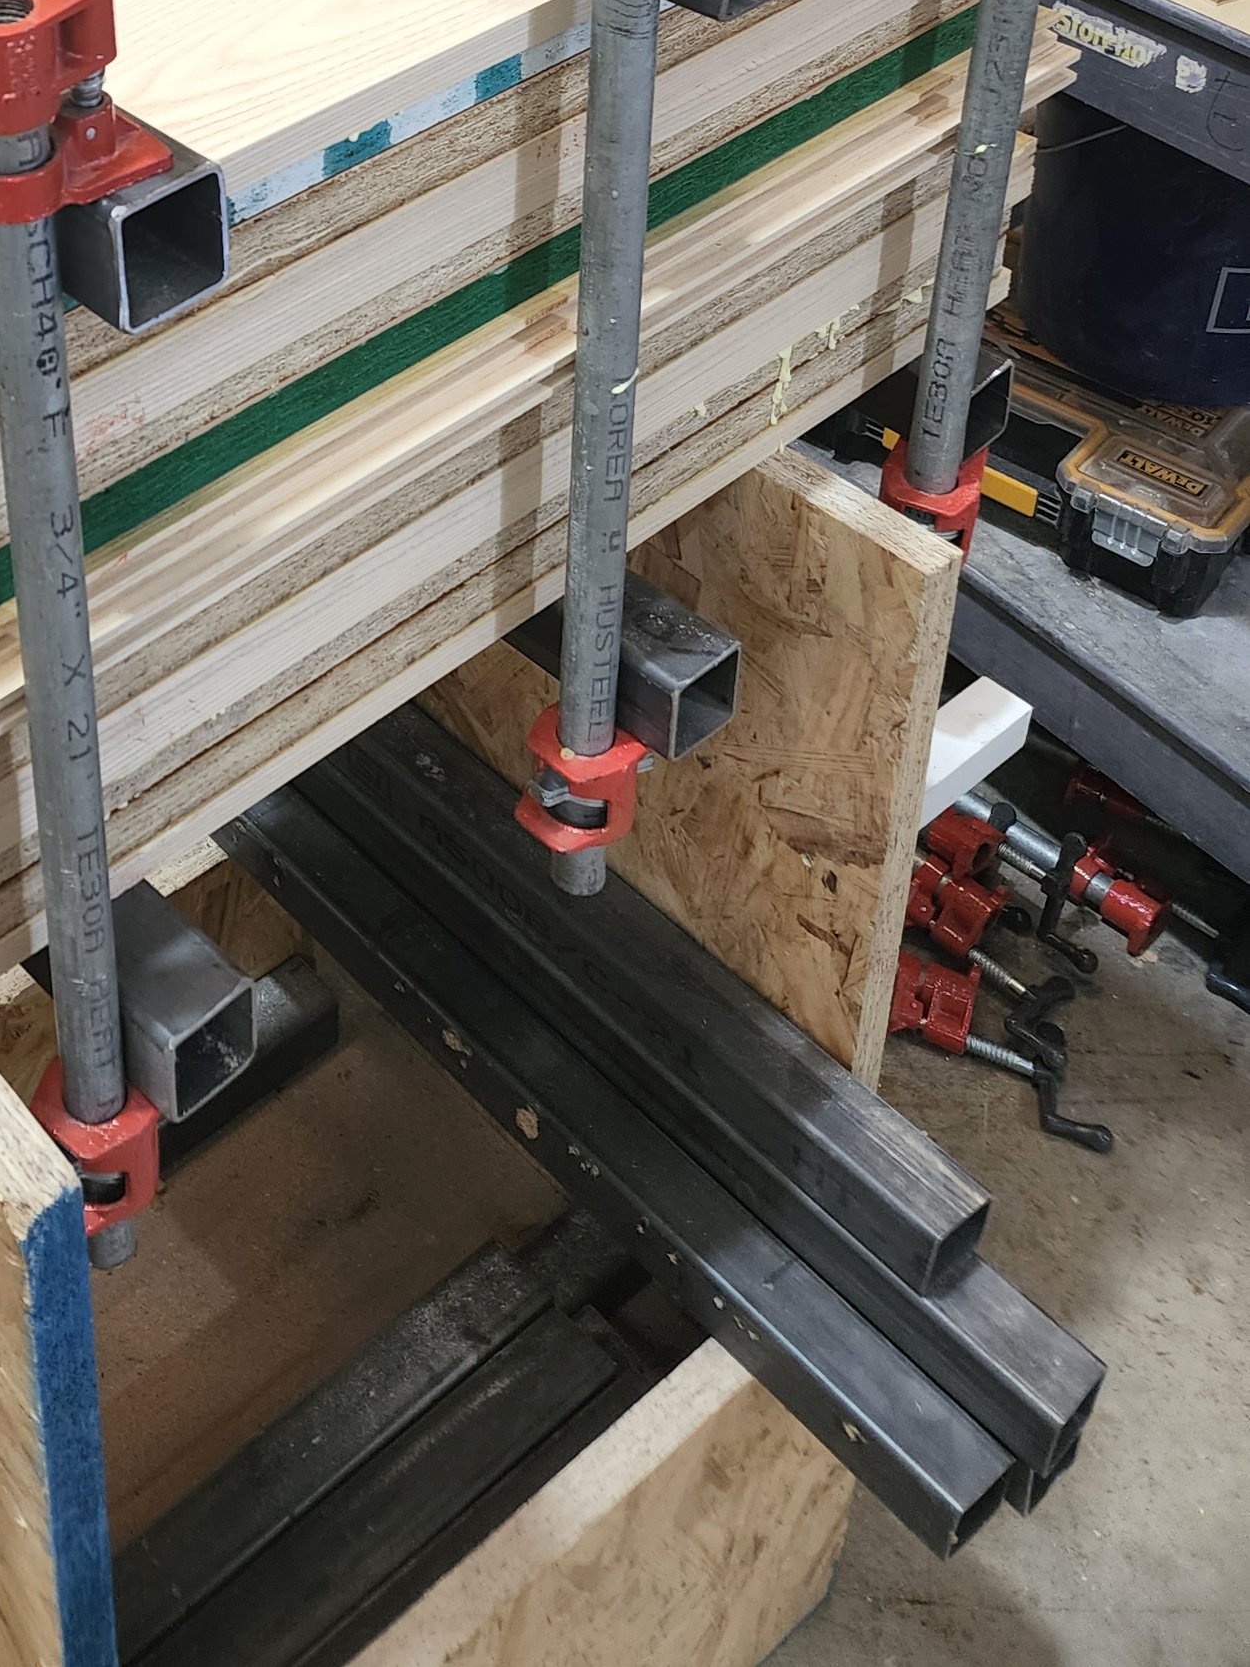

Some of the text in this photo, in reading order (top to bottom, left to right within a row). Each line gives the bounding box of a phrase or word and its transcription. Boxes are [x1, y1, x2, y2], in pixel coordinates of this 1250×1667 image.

[603, 375, 633, 502] KOREA
[1119, 450, 1206, 496] DEWALT
[49, 504, 82, 619] 3/4"
[61, 653, 87, 687] X
[587, 584, 618, 741] HUSTEEL
